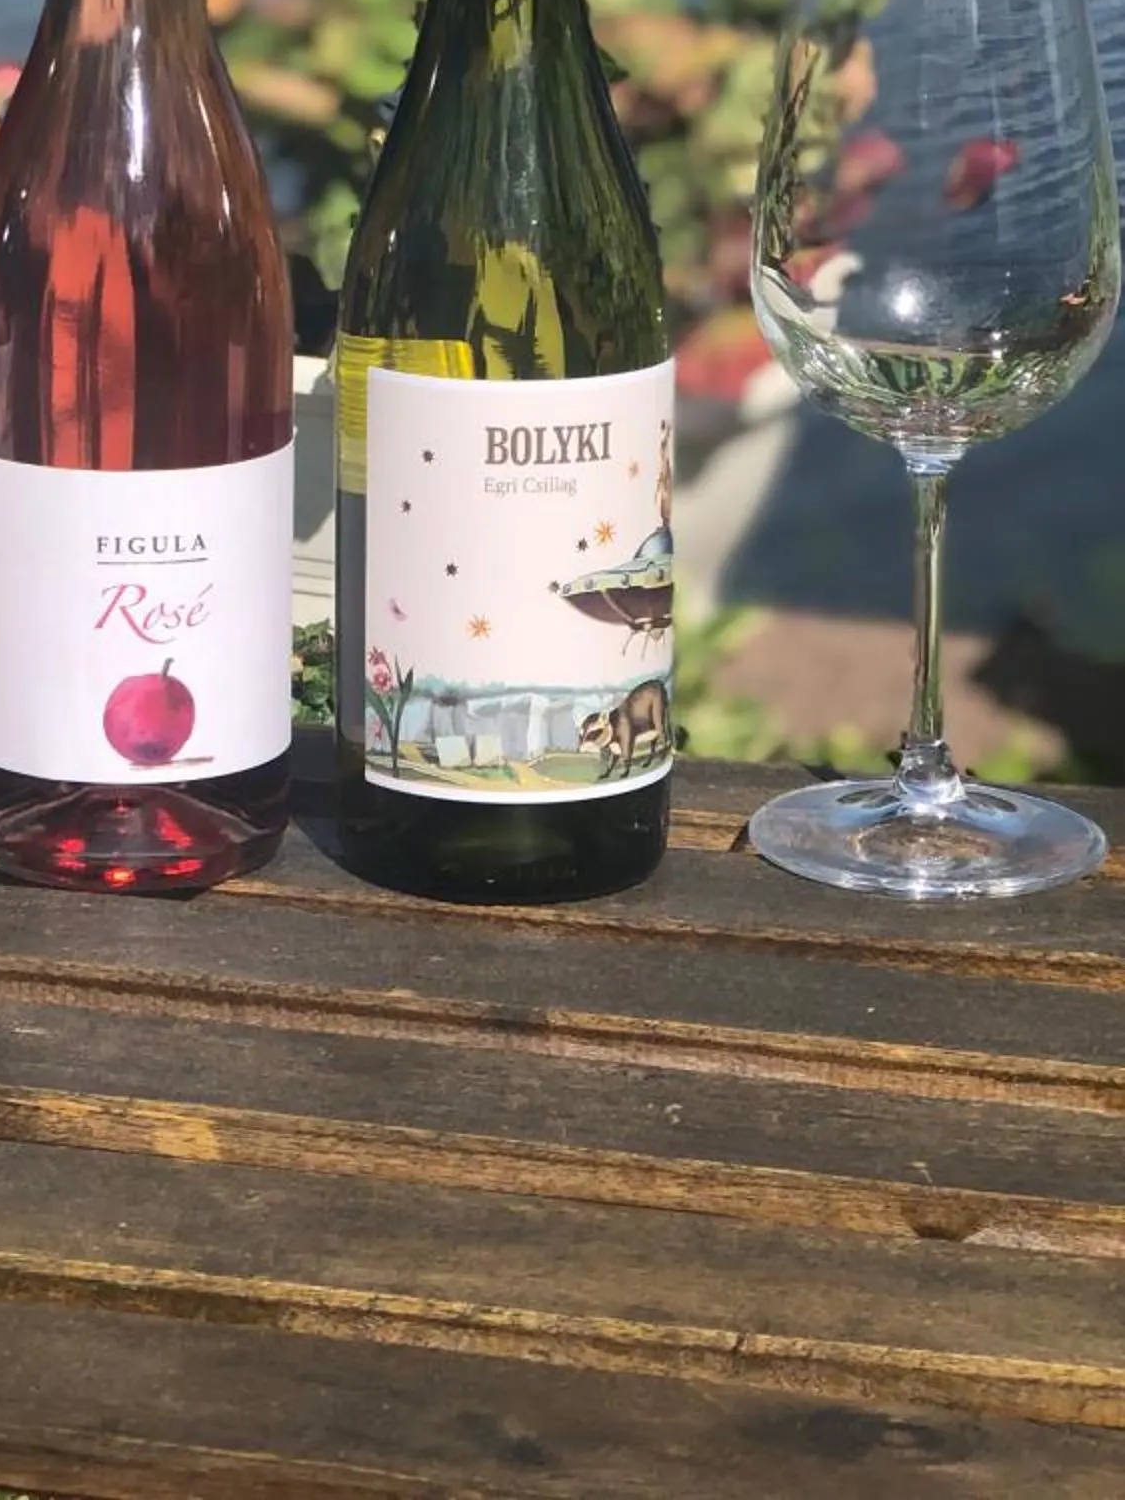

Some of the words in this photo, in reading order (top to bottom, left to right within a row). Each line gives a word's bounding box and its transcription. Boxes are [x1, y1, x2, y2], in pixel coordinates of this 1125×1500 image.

[484, 421, 613, 467] BOLYKI
[483, 476, 518, 500] Egri
[522, 476, 578, 498] Csillag
[96, 534, 208, 555] FIGULA
[93, 582, 215, 645] Rosé
